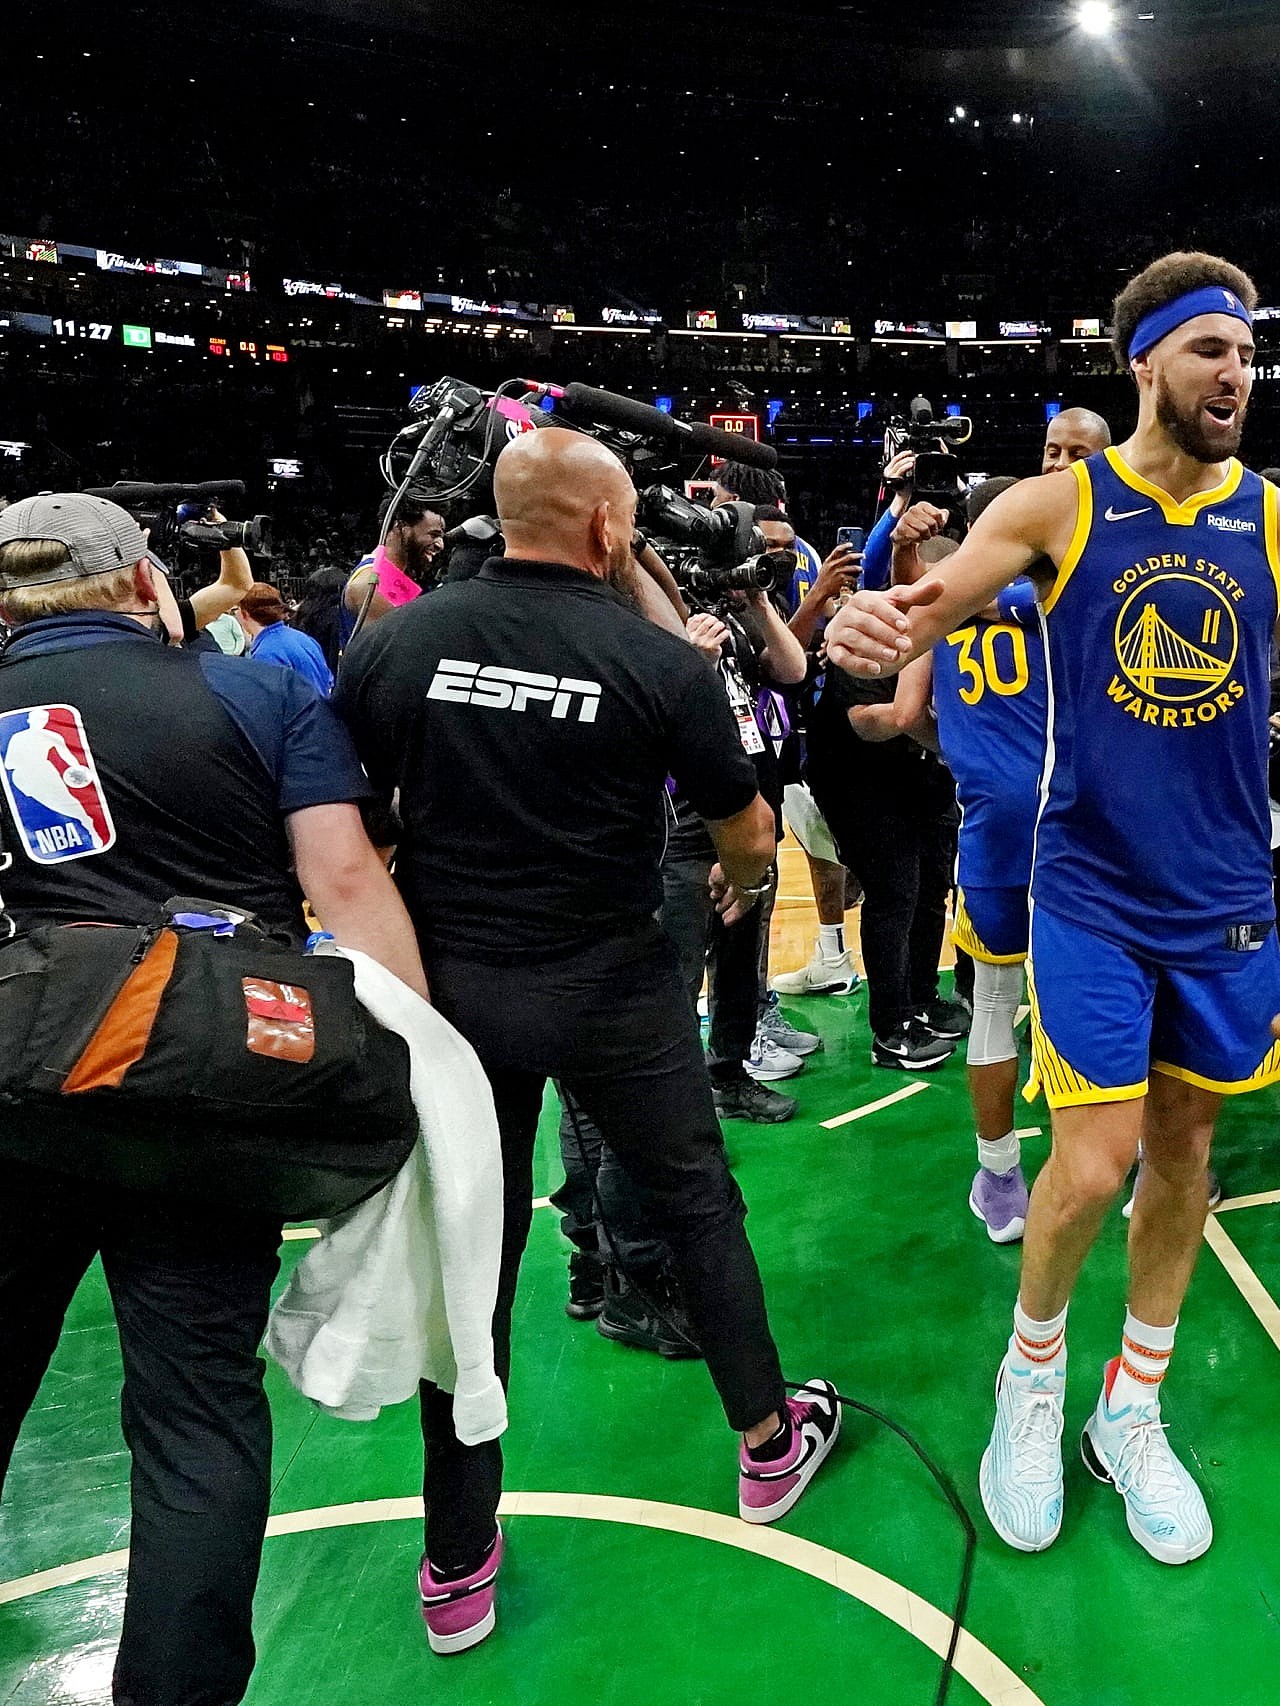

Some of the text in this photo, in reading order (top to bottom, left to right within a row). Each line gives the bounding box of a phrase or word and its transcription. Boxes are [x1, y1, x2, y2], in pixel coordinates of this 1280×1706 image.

[53, 319, 112, 340] 11:27
[128, 330, 147, 342] TD
[155, 332, 195, 346] Bank
[240, 341, 255, 351] 0.0
[272, 352, 288, 362] 103
[725, 420, 743, 432] 0.0
[1207, 513, 1256, 532] Rakuten
[1113, 554, 1245, 601] GOLDEN STATE
[1202, 608, 1221, 645] 11
[946, 625, 1030, 706] 30
[426, 658, 602, 723] ESPN
[1106, 675, 1246, 728] WARRIORS
[35, 822, 83, 854] NBA
